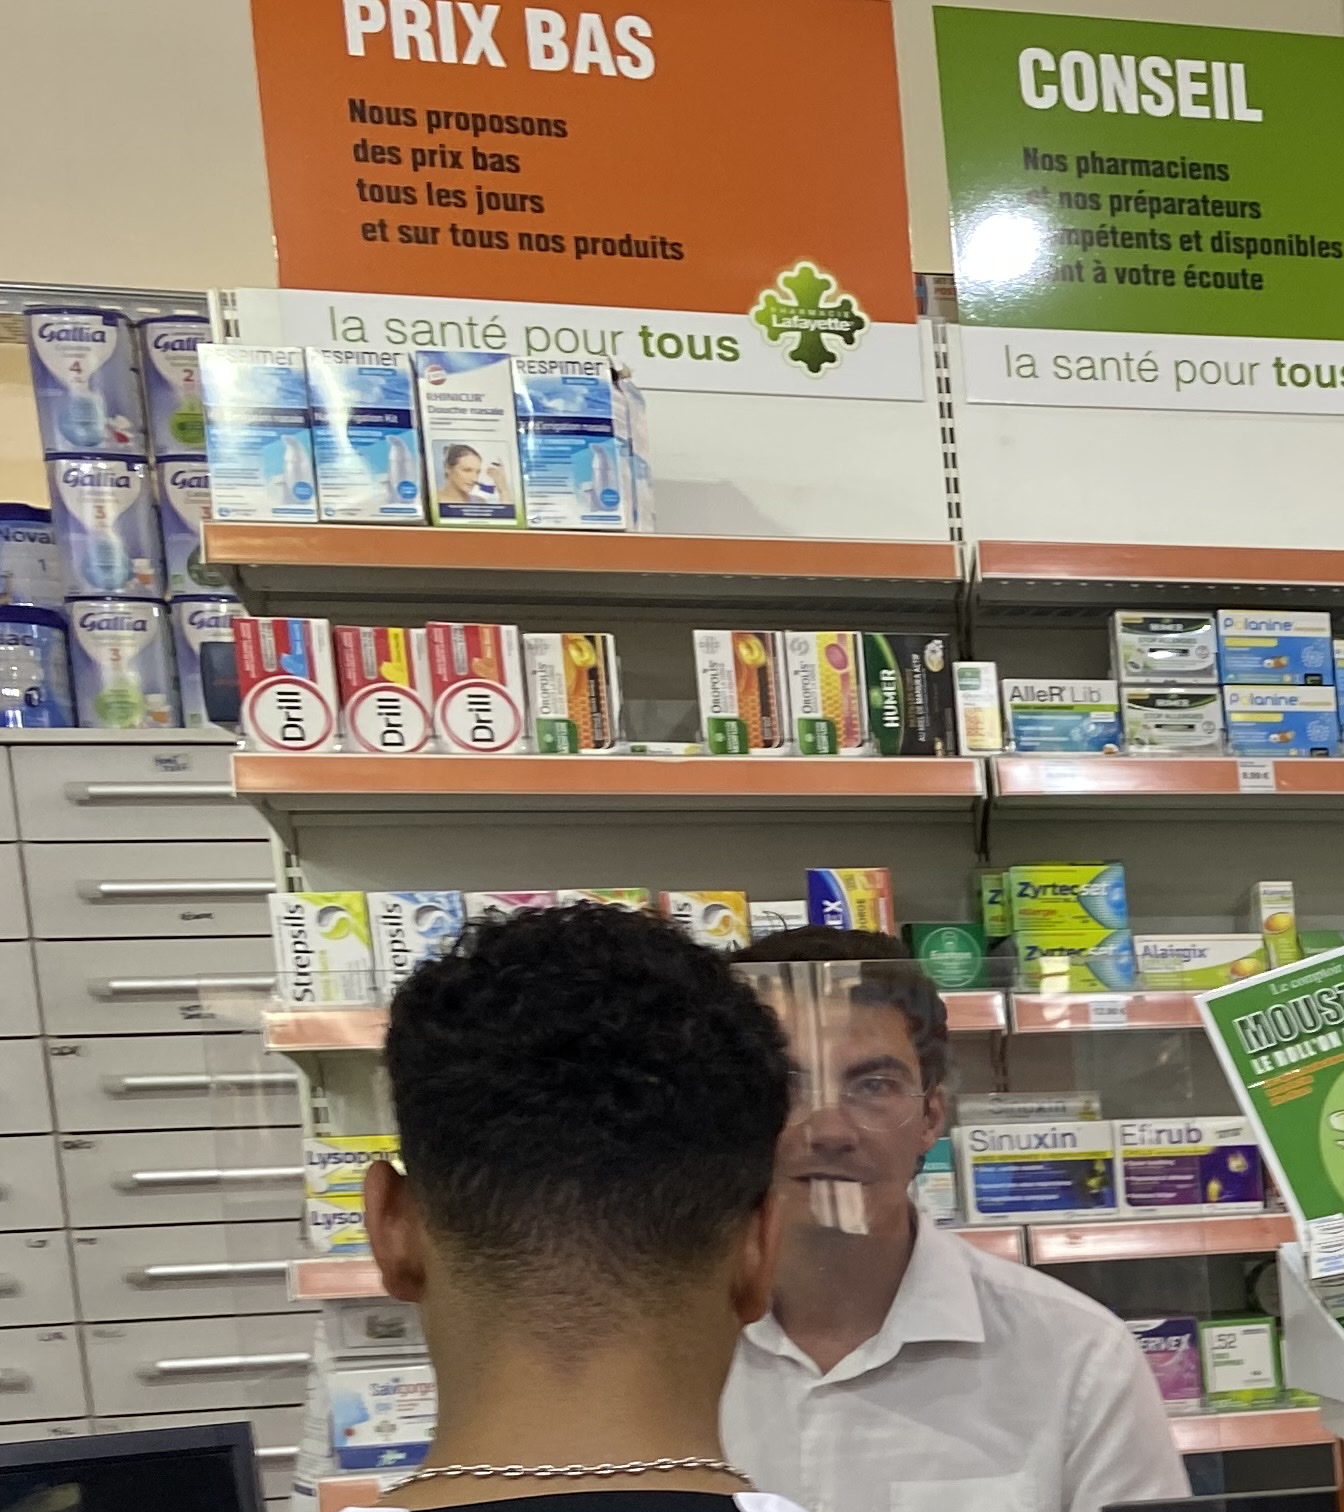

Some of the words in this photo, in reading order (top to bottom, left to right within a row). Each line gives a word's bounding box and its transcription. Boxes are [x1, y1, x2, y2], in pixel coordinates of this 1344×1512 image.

[344, 0, 507, 67] PRIX
[528, 9, 655, 80] BAS
[1018, 47, 1263, 122] CONSEIL
[349, 98, 416, 130] Nous
[426, 107, 567, 139] proposons
[354, 140, 401, 166] des
[411, 144, 463, 173] prix
[472, 147, 520, 174] bas
[1023, 147, 1068, 175] Nos
[1076, 149, 1230, 183] pharmaciens
[356, 178, 416, 205] tous
[426, 181, 467, 209] les
[476, 186, 544, 215] jours
[1059, 190, 1102, 212] nos
[1108, 189, 1262, 219] préparateurs
[362, 218, 388, 244] et
[397, 222, 440, 247] sur
[450, 223, 509, 252] tous
[519, 229, 565, 254] nos
[575, 231, 685, 261] produits
[1178, 229, 1203, 252] et
[1210, 229, 1343, 260] disponibles
[1092, 260, 1107, 286] à
[1115, 262, 1175, 288] votre
[1184, 265, 1263, 291] écoute
[38, 323, 106, 343] Gallia
[329, 305, 369, 344] la
[386, 312, 507, 351] santé
[526, 325, 627, 359] pour
[638, 325, 740, 363] tous
[771, 314, 853, 333] Lafayette
[70, 361, 82, 374] 4
[1004, 345, 1038, 379] la
[1053, 350, 1158, 384] santé
[1175, 361, 1263, 393] pour
[63, 467, 131, 488] Gallia
[79, 613, 148, 632] Gallia
[882, 668, 899, 729] HUMER
[276, 691, 304, 742] Drill
[377, 698, 405, 747] Drill
[468, 693, 494, 743] Drill
[283, 902, 315, 1002] Strepsils
[1268, 980, 1290, 995] Le
[1290, 964, 1343, 990] comptoir
[1251, 1057, 1274, 1076] LE
[969, 1128, 1077, 1152] Sinuxin
[1120, 1123, 1203, 1148] Efirub
